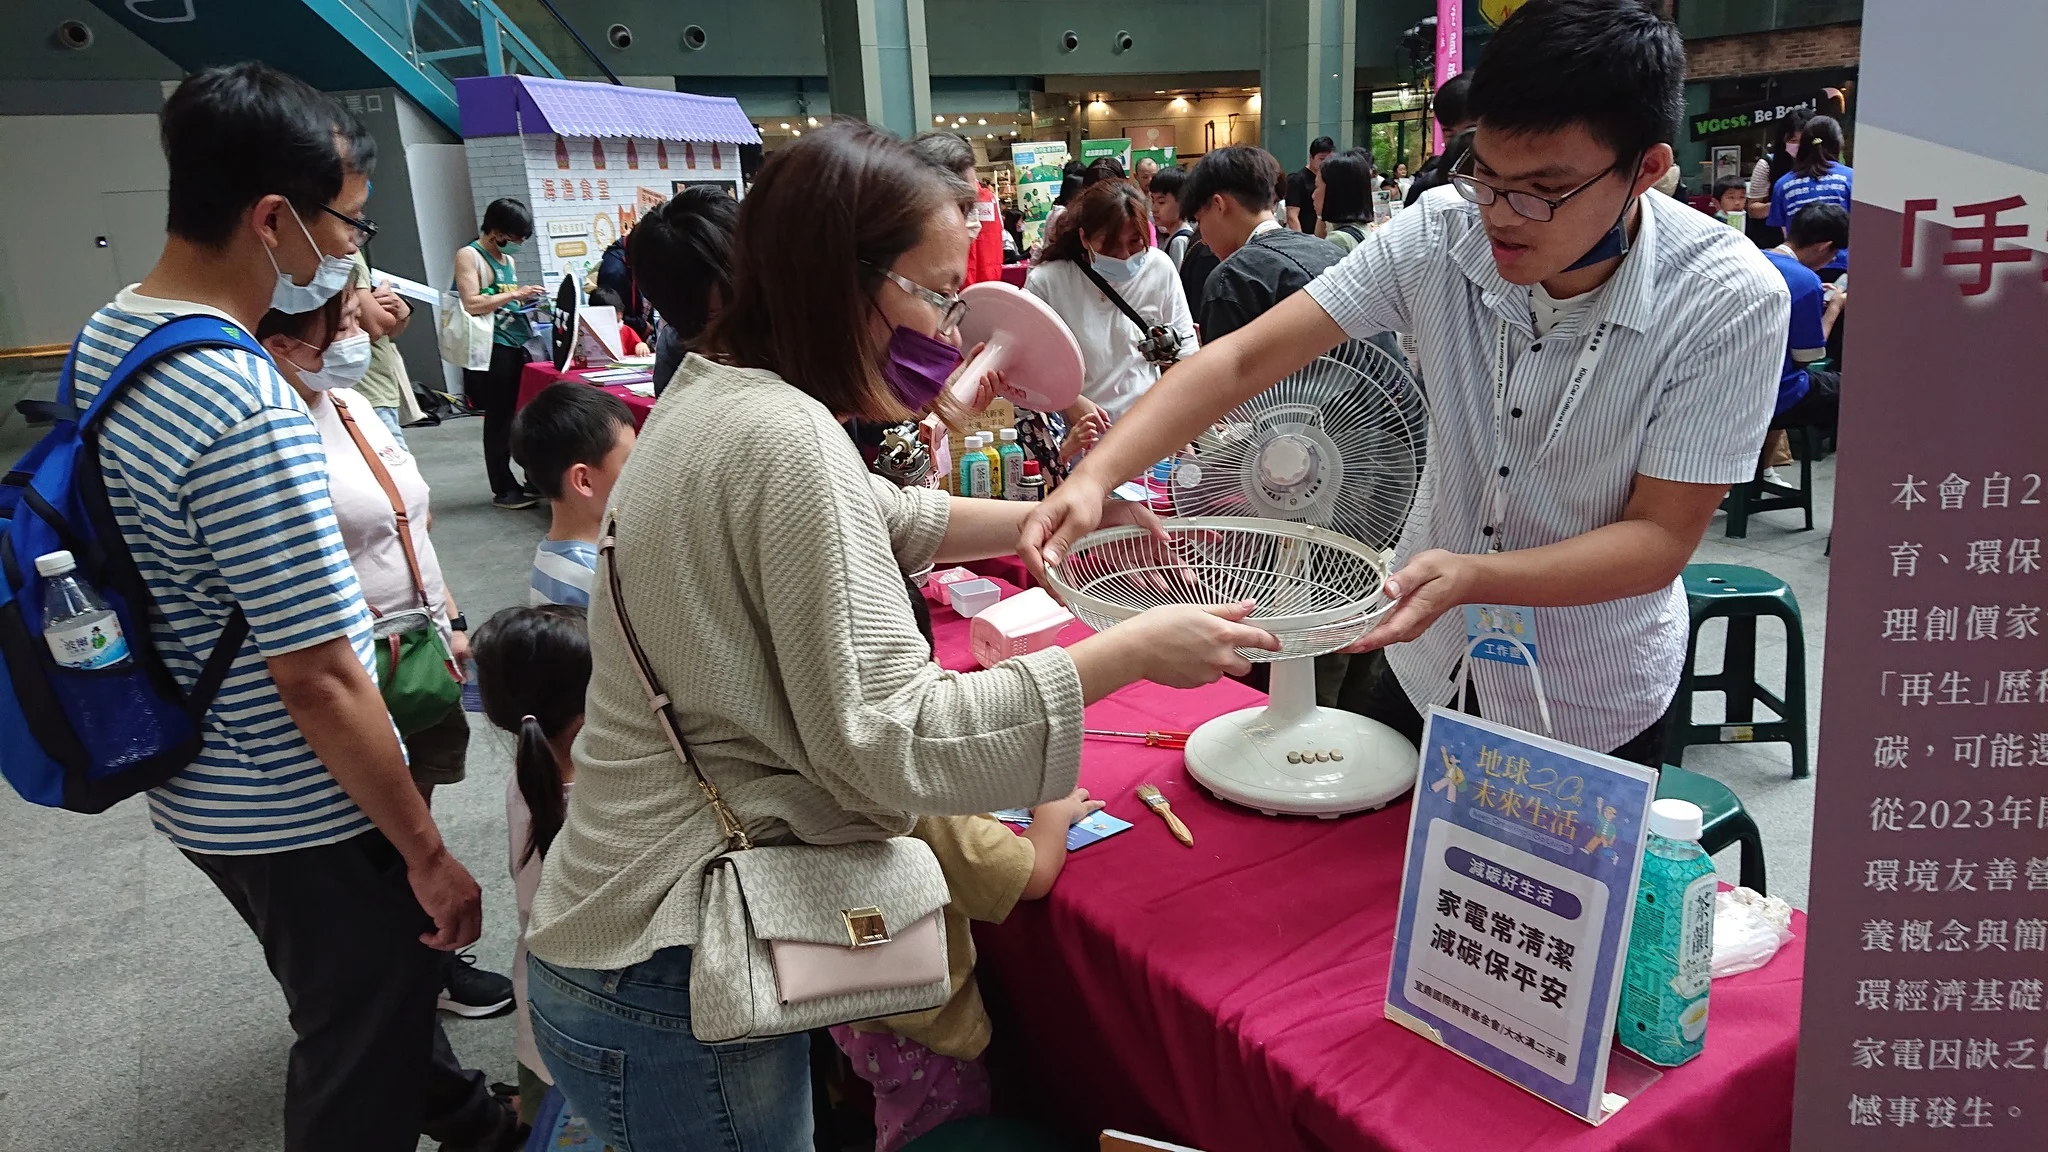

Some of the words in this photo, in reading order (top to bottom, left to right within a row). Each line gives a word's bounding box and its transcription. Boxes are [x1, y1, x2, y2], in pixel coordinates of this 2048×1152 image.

[1754, 109, 1773, 123] Be
[1901, 195, 2048, 297] 「手
[1569, 384, 1580, 396] Car
[1574, 367, 1588, 383] King
[1890, 471, 2042, 511] 本會自2
[1888, 537, 2042, 577] 育、環保
[1881, 603, 2042, 642] 理創價家
[1471, 778, 1580, 841] 未來生活
[1468, 857, 1555, 908] 減碳好生活
[1436, 887, 1576, 972] 家電常清潔
[1860, 918, 2048, 953] 養概念與簡
[1430, 922, 1568, 1010] 減碳保平安
[1852, 1037, 2048, 1071] 家電因缺乏
[1848, 1093, 2022, 1129] 憾事發生。
